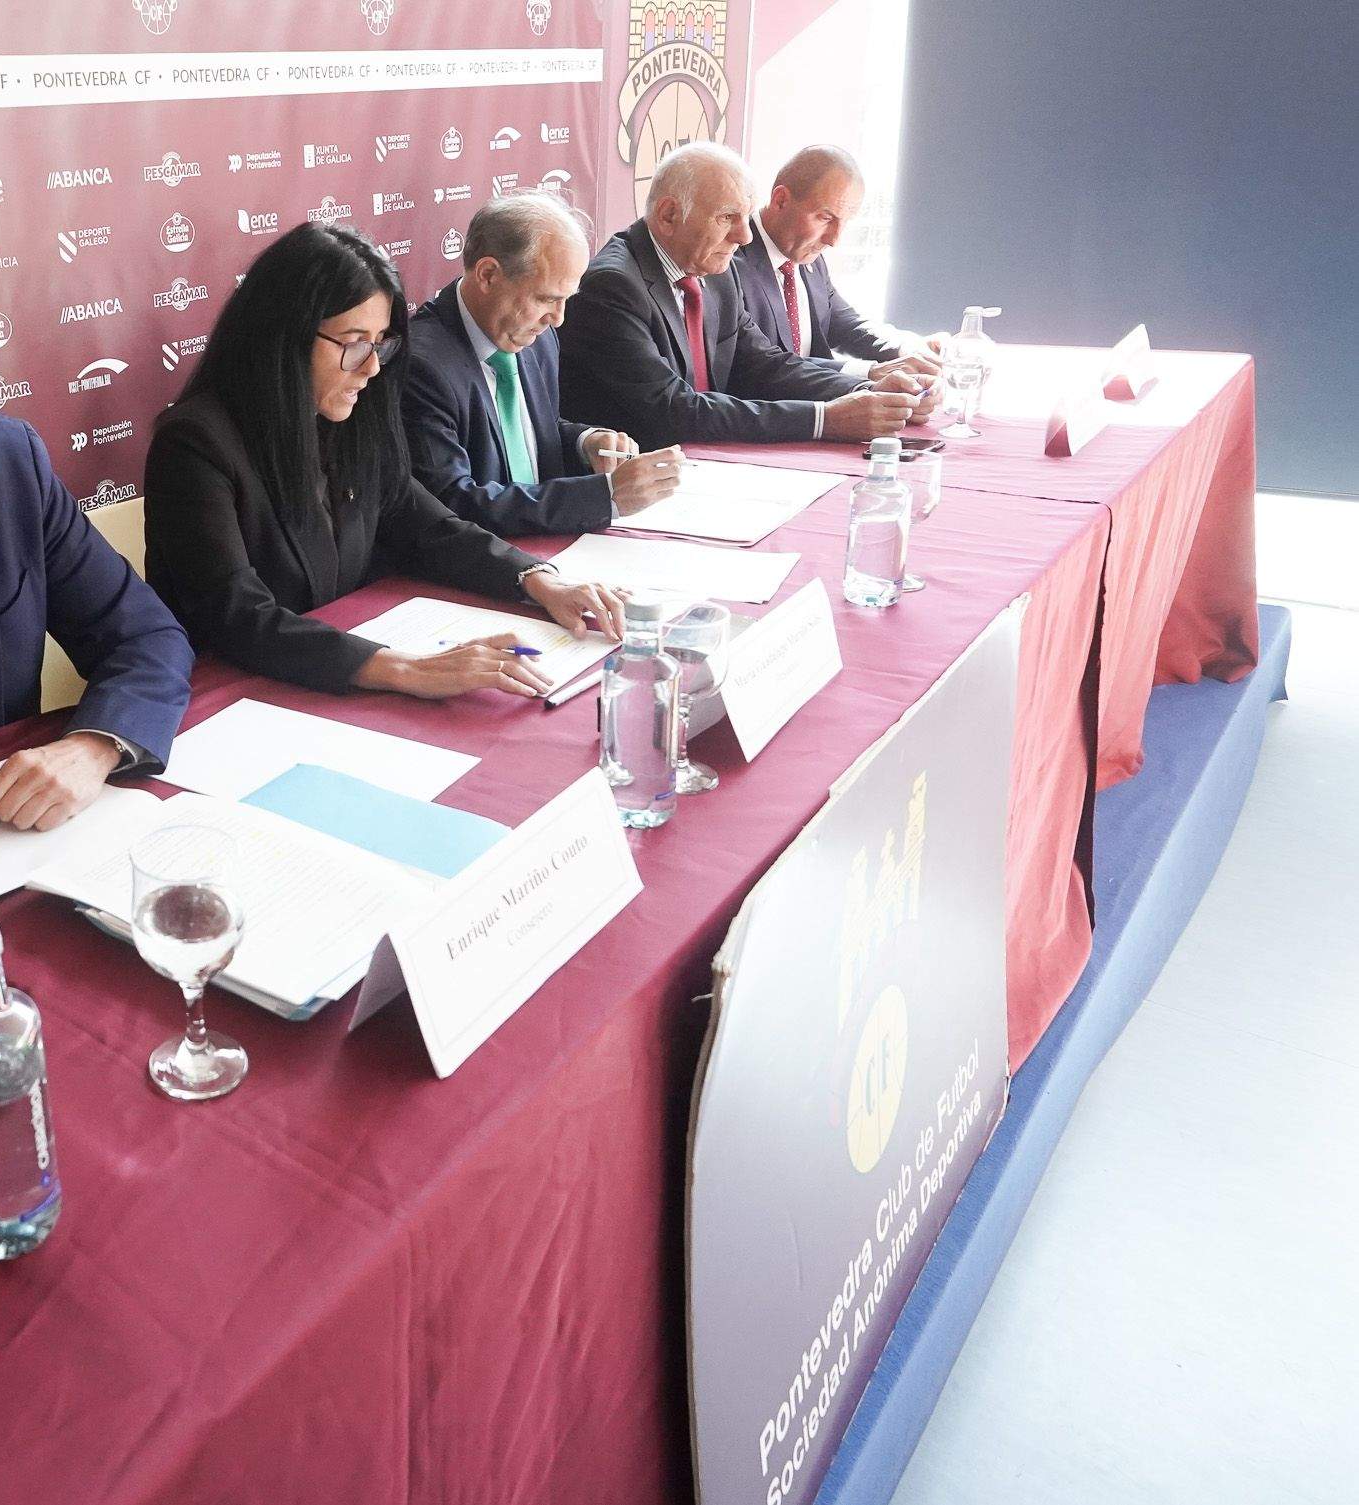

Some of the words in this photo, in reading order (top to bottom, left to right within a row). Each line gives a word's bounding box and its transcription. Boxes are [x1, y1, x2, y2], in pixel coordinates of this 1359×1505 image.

[33, 71, 127, 89] PONTEVEDRA
[135, 70, 152, 85] CF
[172, 68, 251, 84] PONTEVEDRA
[256, 67, 271, 81] CF
[288, 65, 355, 80] PONTEVEDRA
[359, 64, 371, 78] CF
[385, 63, 442, 77] PONTEVEDRA
[631, 48, 722, 98] PONTEVEDRA
[549, 127, 570, 140] ence
[316, 144, 339, 155] XUNTA
[316, 155, 325, 165] DE
[326, 153, 352, 164] GALICIA
[144, 162, 201, 181] PESCAMAR
[250, 212, 278, 229] ence
[307, 204, 352, 222] PESCAMAR
[78, 226, 111, 238] DEPORTE
[78, 236, 109, 248] GALEGO
[153, 285, 208, 308] PESCAMAR
[180, 335, 207, 348] DEPORTE
[180, 344, 206, 356] GALEGO
[92, 419, 132, 437] Deputación
[93, 428, 133, 446] Pontevedra
[77, 483, 137, 512] PESCAMAR
[445, 908, 501, 961] Enrique
[502, 867, 550, 907] Mariño
[551, 834, 589, 871] Couto
[852, 1207, 919, 1352] Anónima
[919, 1090, 982, 1214] Deportiva
[758, 1238, 874, 1477] Pontevedra
[875, 1163, 913, 1243] Club
[915, 1126, 935, 1171] de
